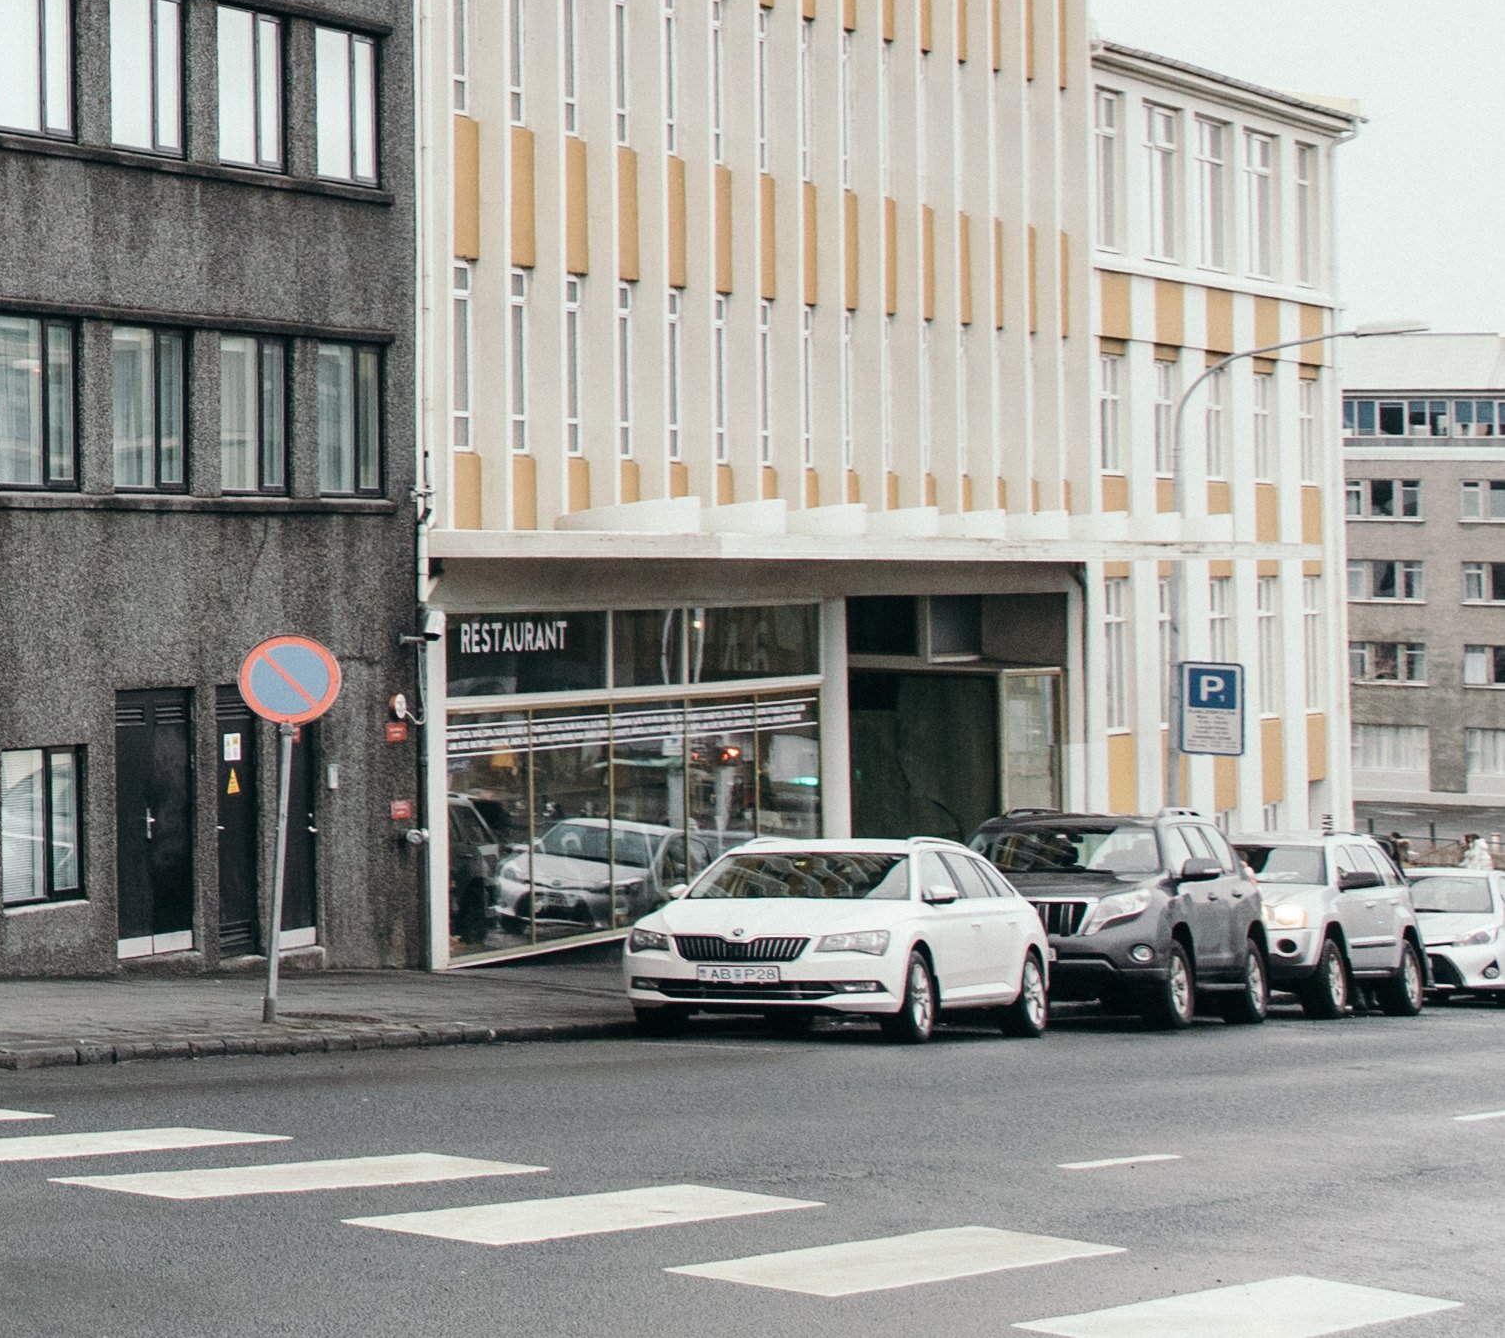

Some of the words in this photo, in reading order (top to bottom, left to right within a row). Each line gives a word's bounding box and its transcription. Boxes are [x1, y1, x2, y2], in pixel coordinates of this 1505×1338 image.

[460, 621, 568, 654] RESTAURANT
[1199, 674, 1226, 702] P
[710, 968, 732, 980] AB
[744, 968, 777, 980] P28
